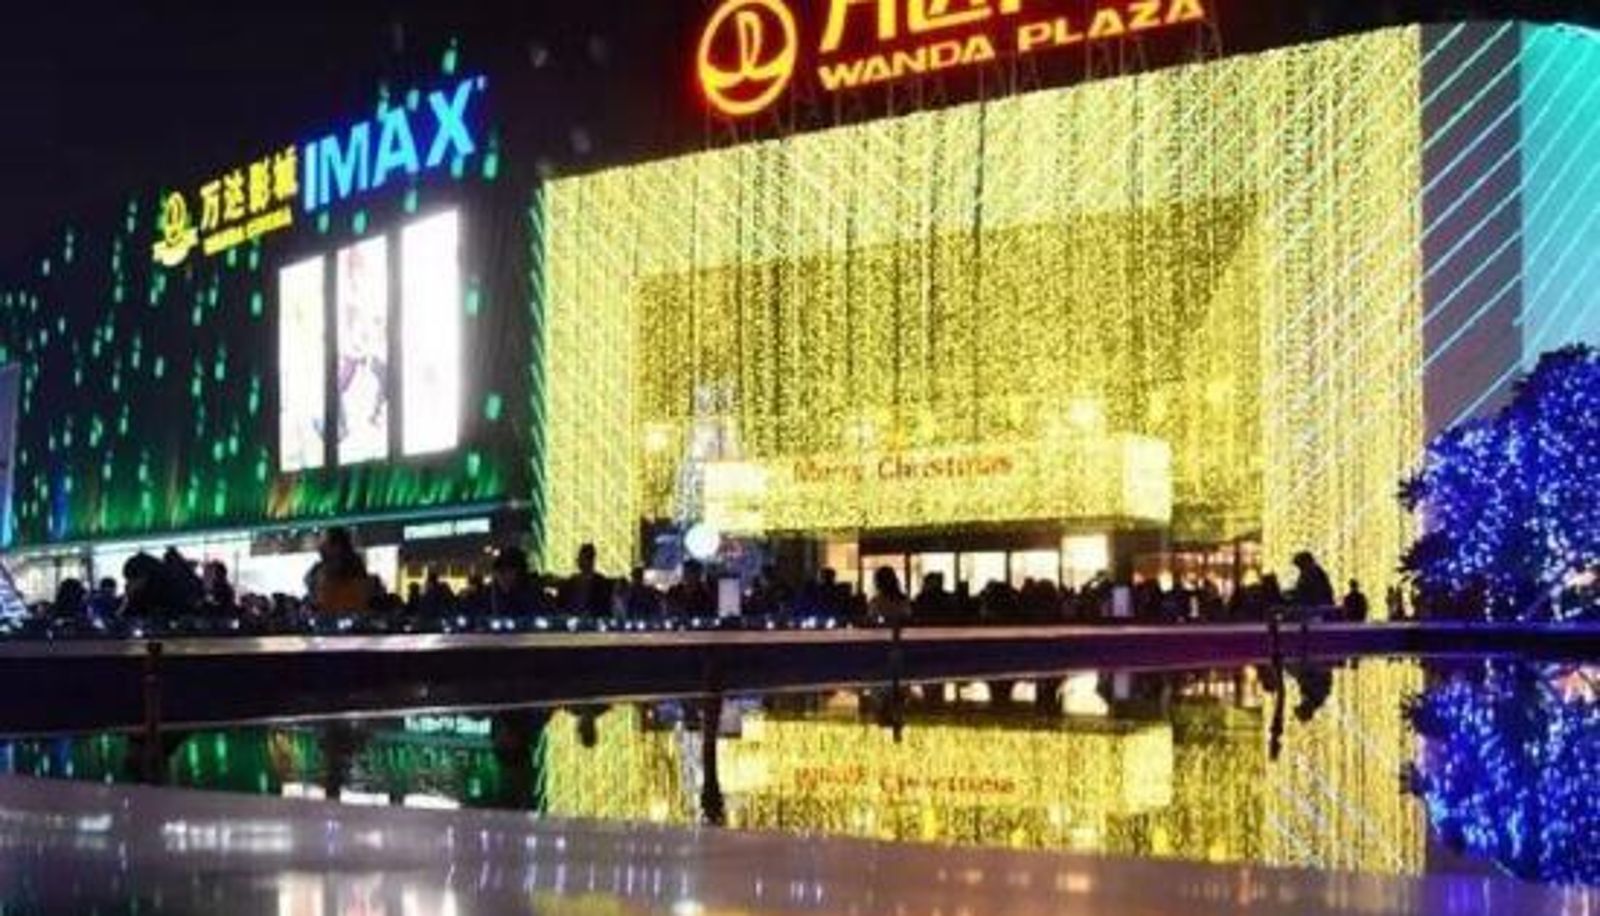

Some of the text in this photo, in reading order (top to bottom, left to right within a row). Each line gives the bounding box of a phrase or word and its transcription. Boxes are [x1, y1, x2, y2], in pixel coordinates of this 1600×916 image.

[818, 35, 995, 90] WANDA
[1017, 0, 1205, 52] PLAZA
[303, 79, 475, 212] IMAX
